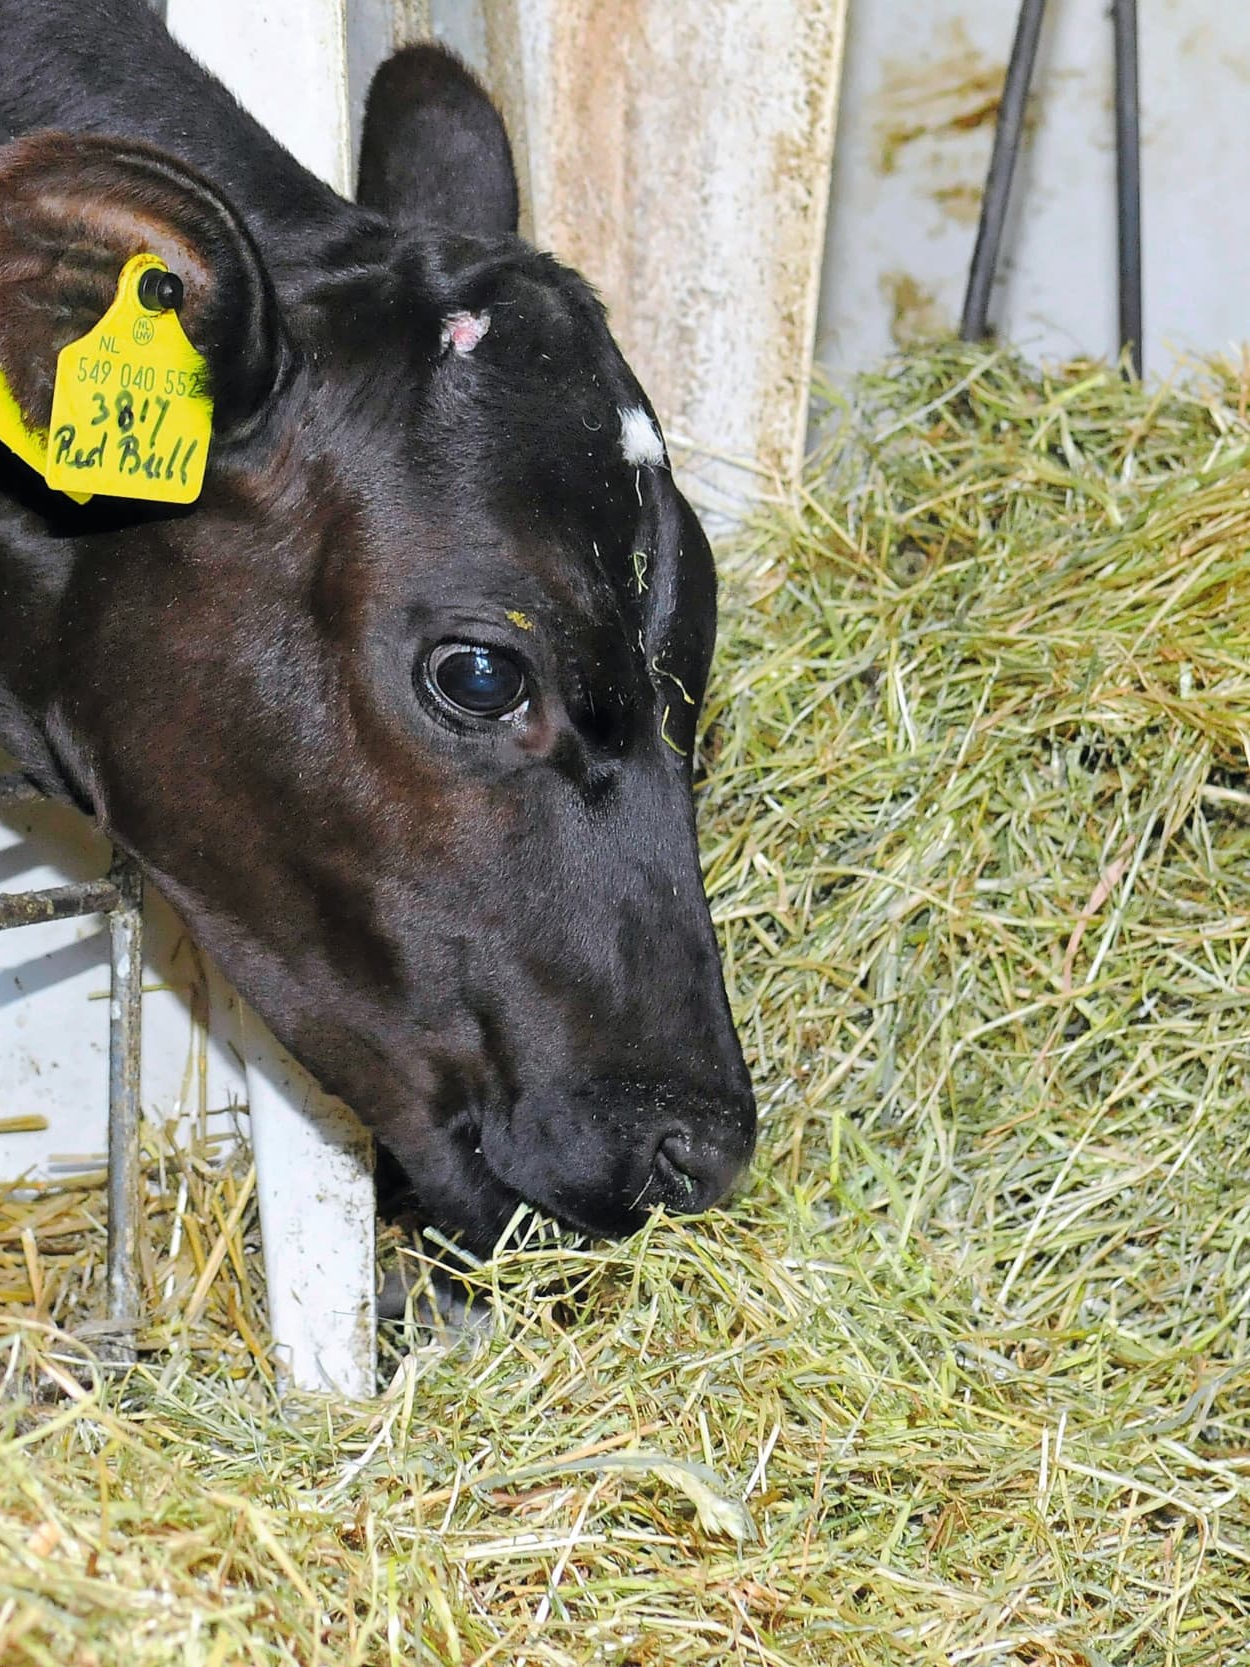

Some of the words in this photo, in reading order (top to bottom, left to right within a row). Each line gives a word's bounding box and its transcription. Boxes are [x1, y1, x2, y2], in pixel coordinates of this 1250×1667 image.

[99, 335, 120, 354] NL
[77, 356, 112, 385] 549
[120, 363, 155, 392] 040
[164, 369, 204, 398] 552
[91, 389, 170, 448] 3817
[54, 423, 108, 469] Red
[116, 433, 198, 486] Bull
